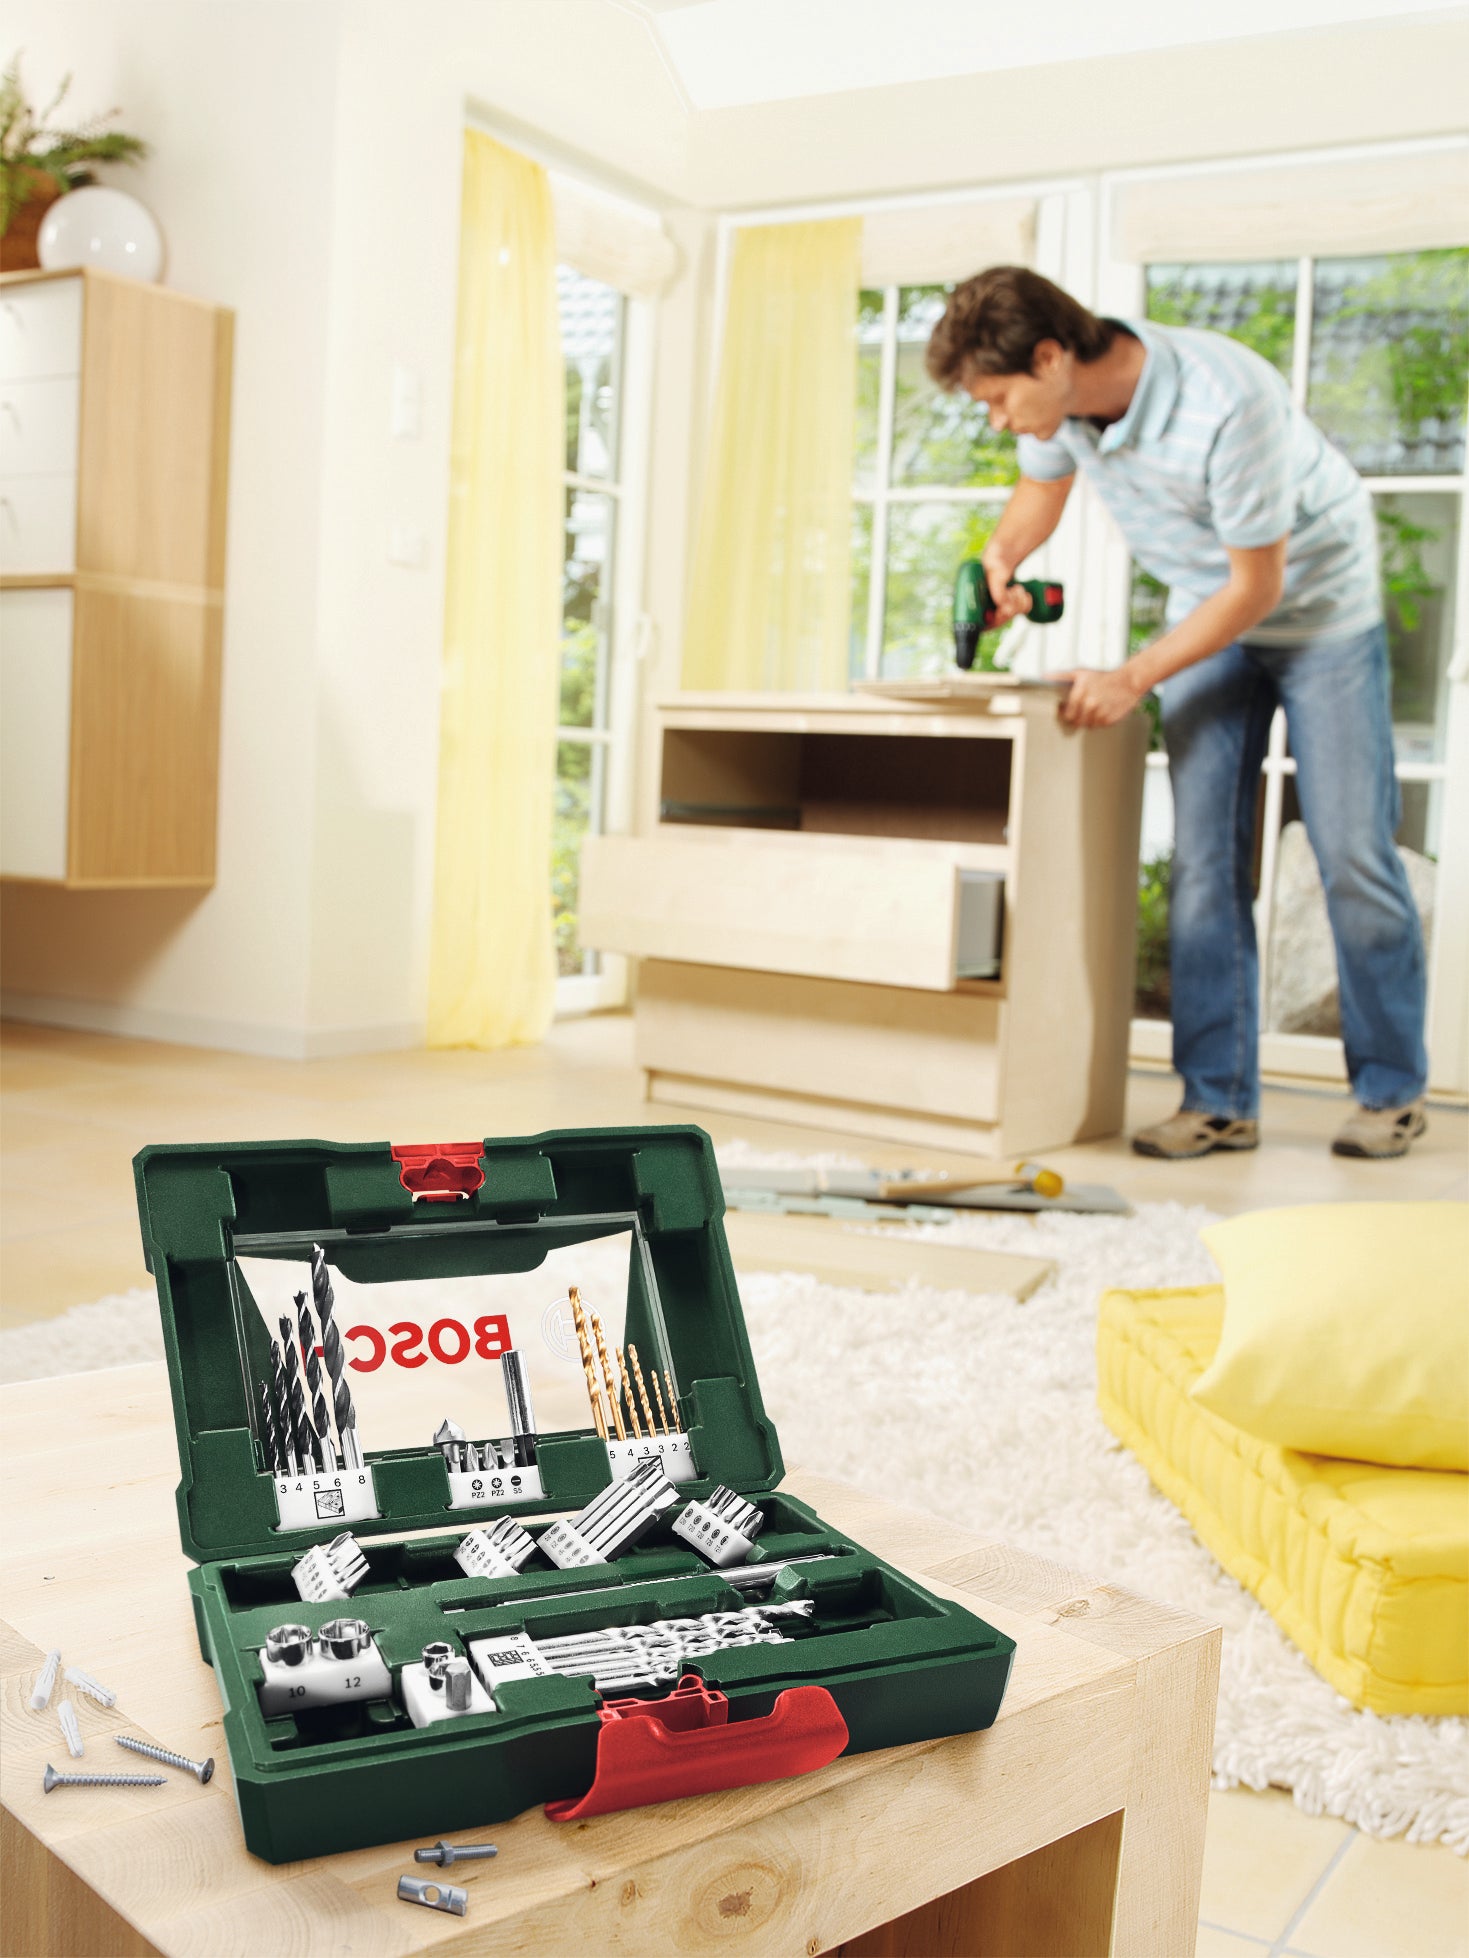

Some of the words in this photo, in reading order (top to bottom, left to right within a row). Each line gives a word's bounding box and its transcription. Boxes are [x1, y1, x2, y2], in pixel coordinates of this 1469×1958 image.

[609, 1450, 616, 1459] 5
[627, 1448, 634, 1457] 4
[643, 1446, 650, 1455] 3
[658, 1444, 665, 1454] 3
[671, 1443, 678, 1452] 2
[280, 1484, 287, 1494] 3
[295, 1482, 303, 1492] 4
[313, 1480, 320, 1490] 5
[334, 1477, 341, 1487] 6
[358, 1474, 366, 1484] 8
[471, 1491, 485, 1499] PZ2
[491, 1489, 505, 1497] PZ2
[289, 1685, 306, 1698] 10
[345, 1676, 361, 1689] 12
